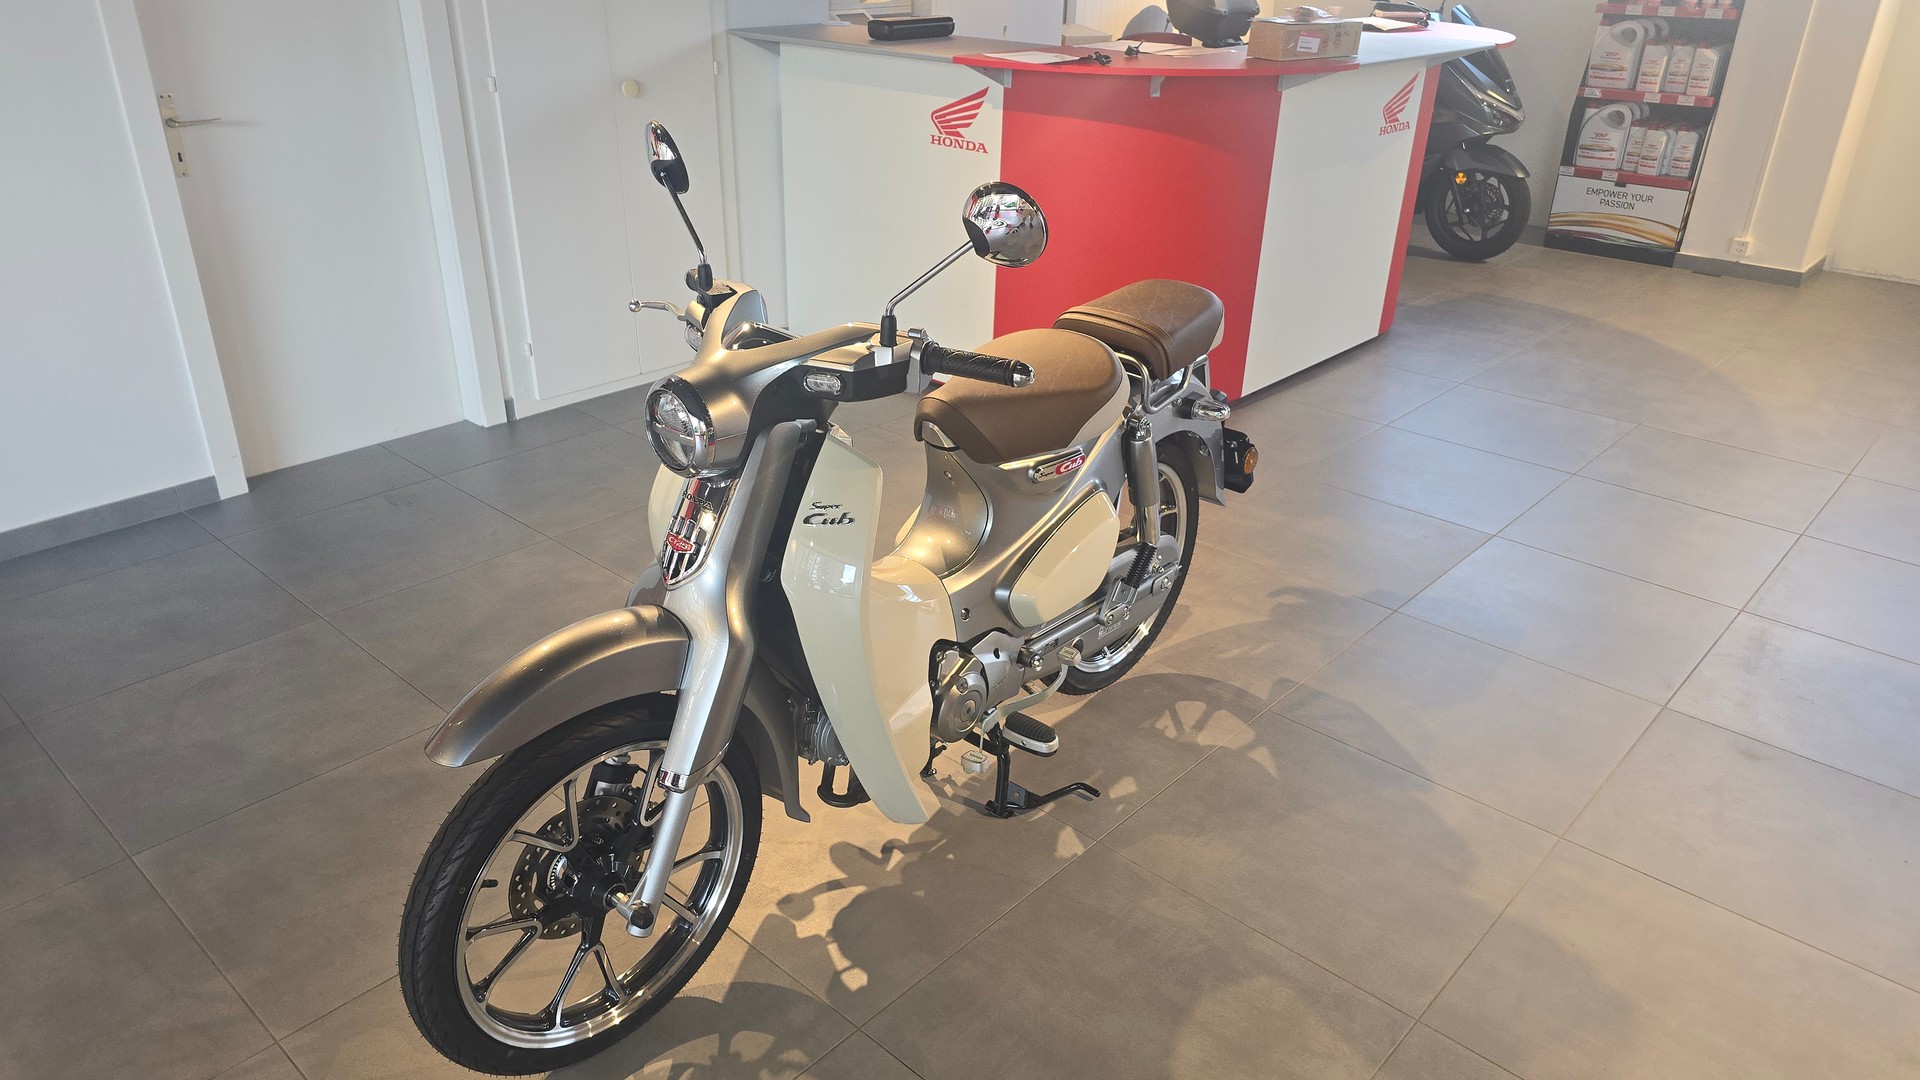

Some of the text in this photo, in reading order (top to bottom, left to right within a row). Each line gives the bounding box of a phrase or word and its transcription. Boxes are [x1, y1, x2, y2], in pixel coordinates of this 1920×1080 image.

[1379, 121, 1411, 136] HONDA
[930, 134, 988, 154] HONDA
[1586, 187, 1654, 203] EMPOWER YOUR
[1600, 198, 1635, 210] PASSION
[1060, 457, 1083, 472] Cub
[809, 501, 843, 511] Super
[803, 512, 856, 526] Cub
